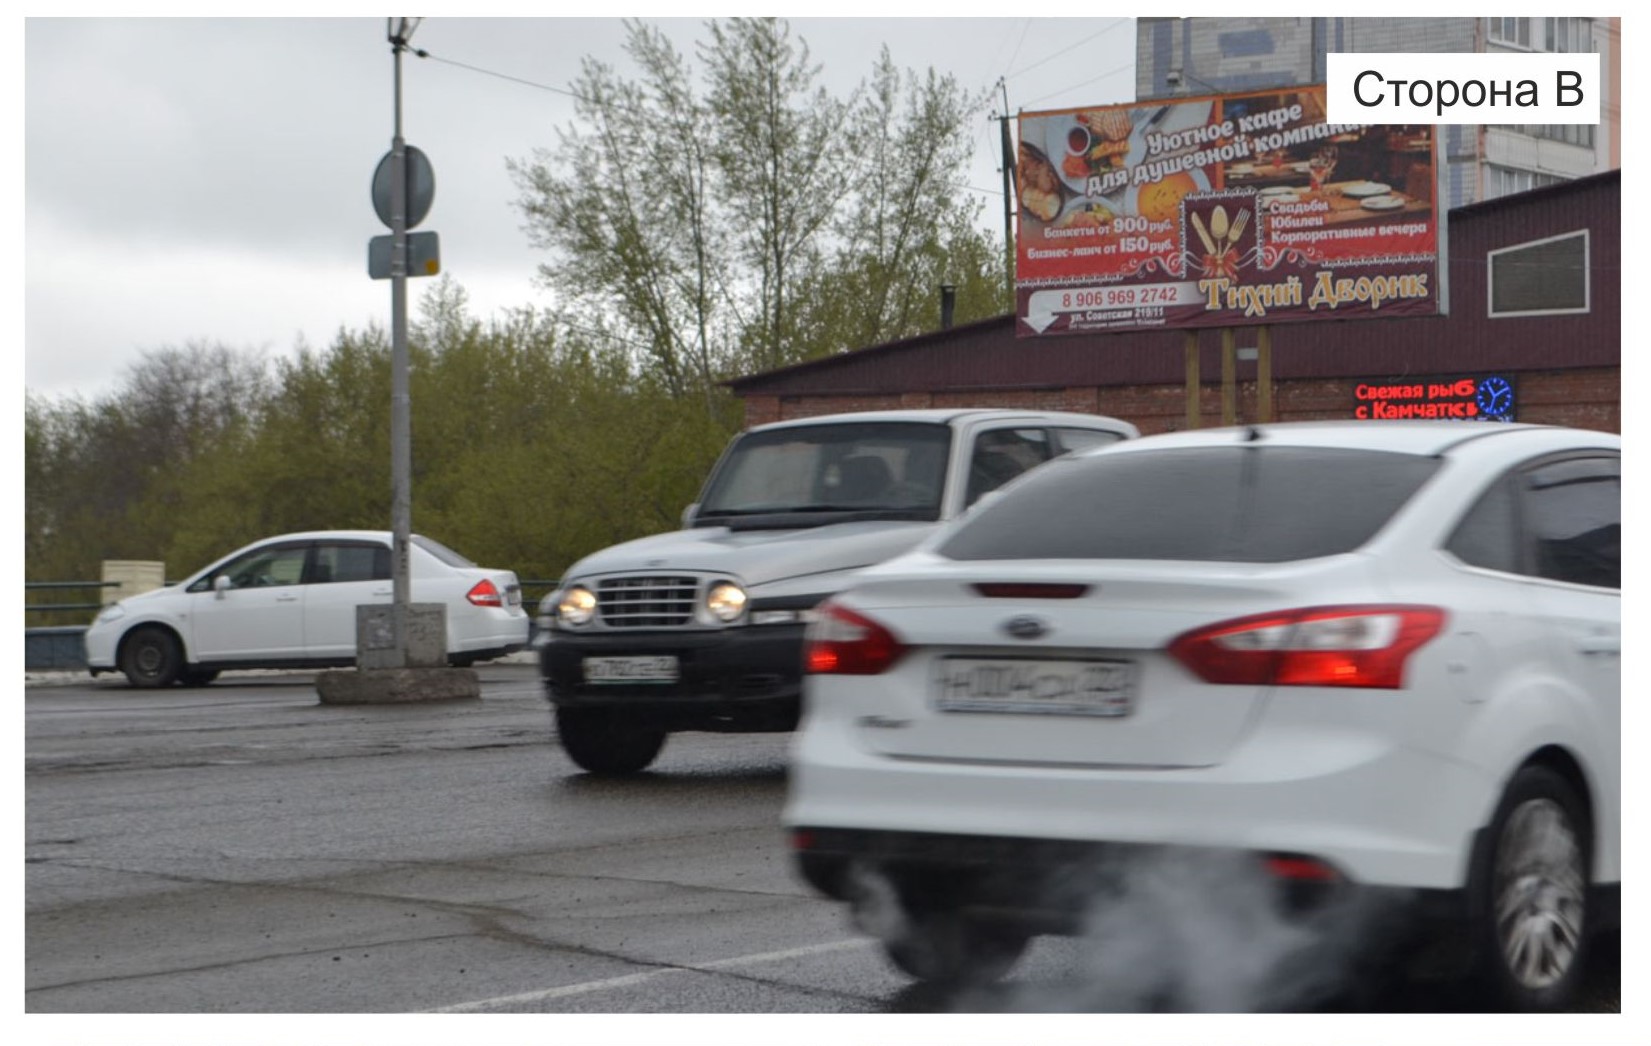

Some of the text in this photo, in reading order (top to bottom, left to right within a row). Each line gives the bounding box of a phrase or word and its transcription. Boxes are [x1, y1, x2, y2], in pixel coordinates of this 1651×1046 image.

[1147, 104, 1301, 153] Уютное кафе
[1087, 170, 1128, 197] для
[1133, 134, 1250, 186] душевной
[1269, 200, 1329, 215] Свадьбы
[1044, 216, 1173, 238] Банкеты от 900 руб.
[1271, 216, 1324, 229] Юбилеи
[1271, 223, 1427, 244] Корпоративные вечера
[1027, 236, 1175, 260] Бизнес-ланч от 150 руб.
[1062, 287, 1178, 308] 8 906 969 2742
[1199, 271, 1428, 317] Тихий Дворик
[1070, 313, 1084, 324] ул.
[1086, 310, 1133, 321] Советская
[1355, 385, 1423, 399] Свежая
[1355, 405, 1368, 420] с
